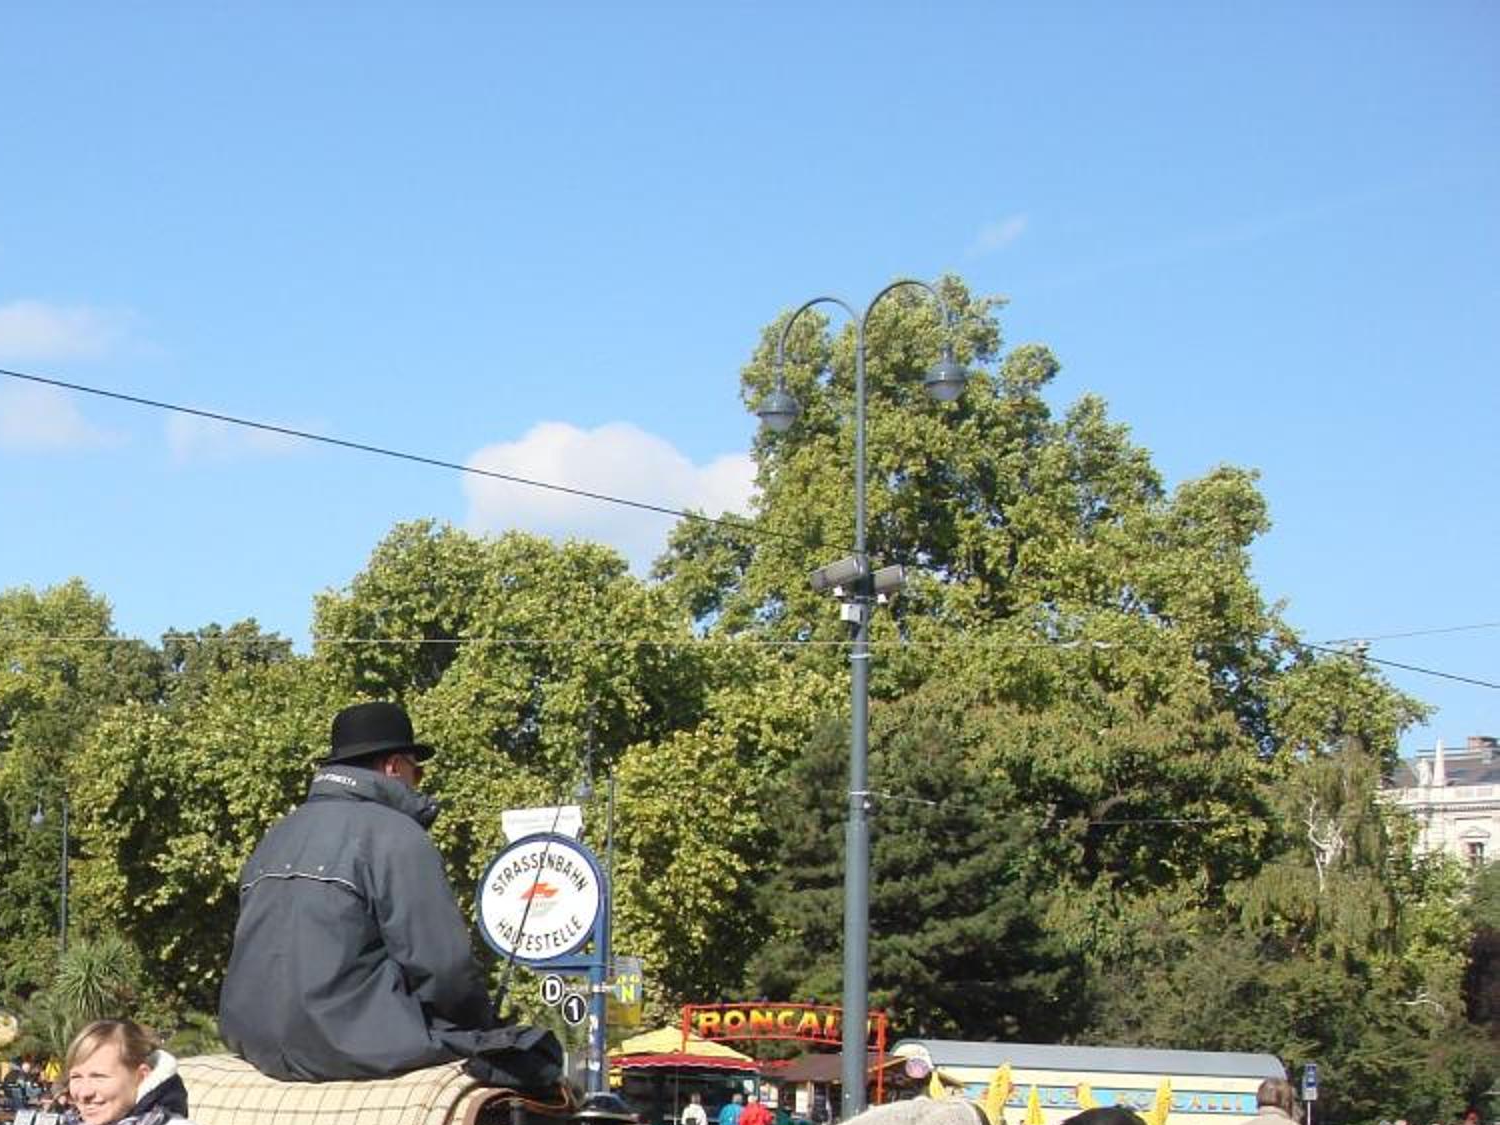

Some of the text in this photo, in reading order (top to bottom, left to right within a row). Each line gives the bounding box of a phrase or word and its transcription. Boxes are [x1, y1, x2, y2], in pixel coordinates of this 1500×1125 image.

[491, 852, 588, 895] STRASSENBAHN
[496, 915, 582, 951] HALTESTELLE
[545, 980, 561, 1001] D
[568, 998, 579, 1021] 1
[698, 1009, 873, 1040] RONCAL
